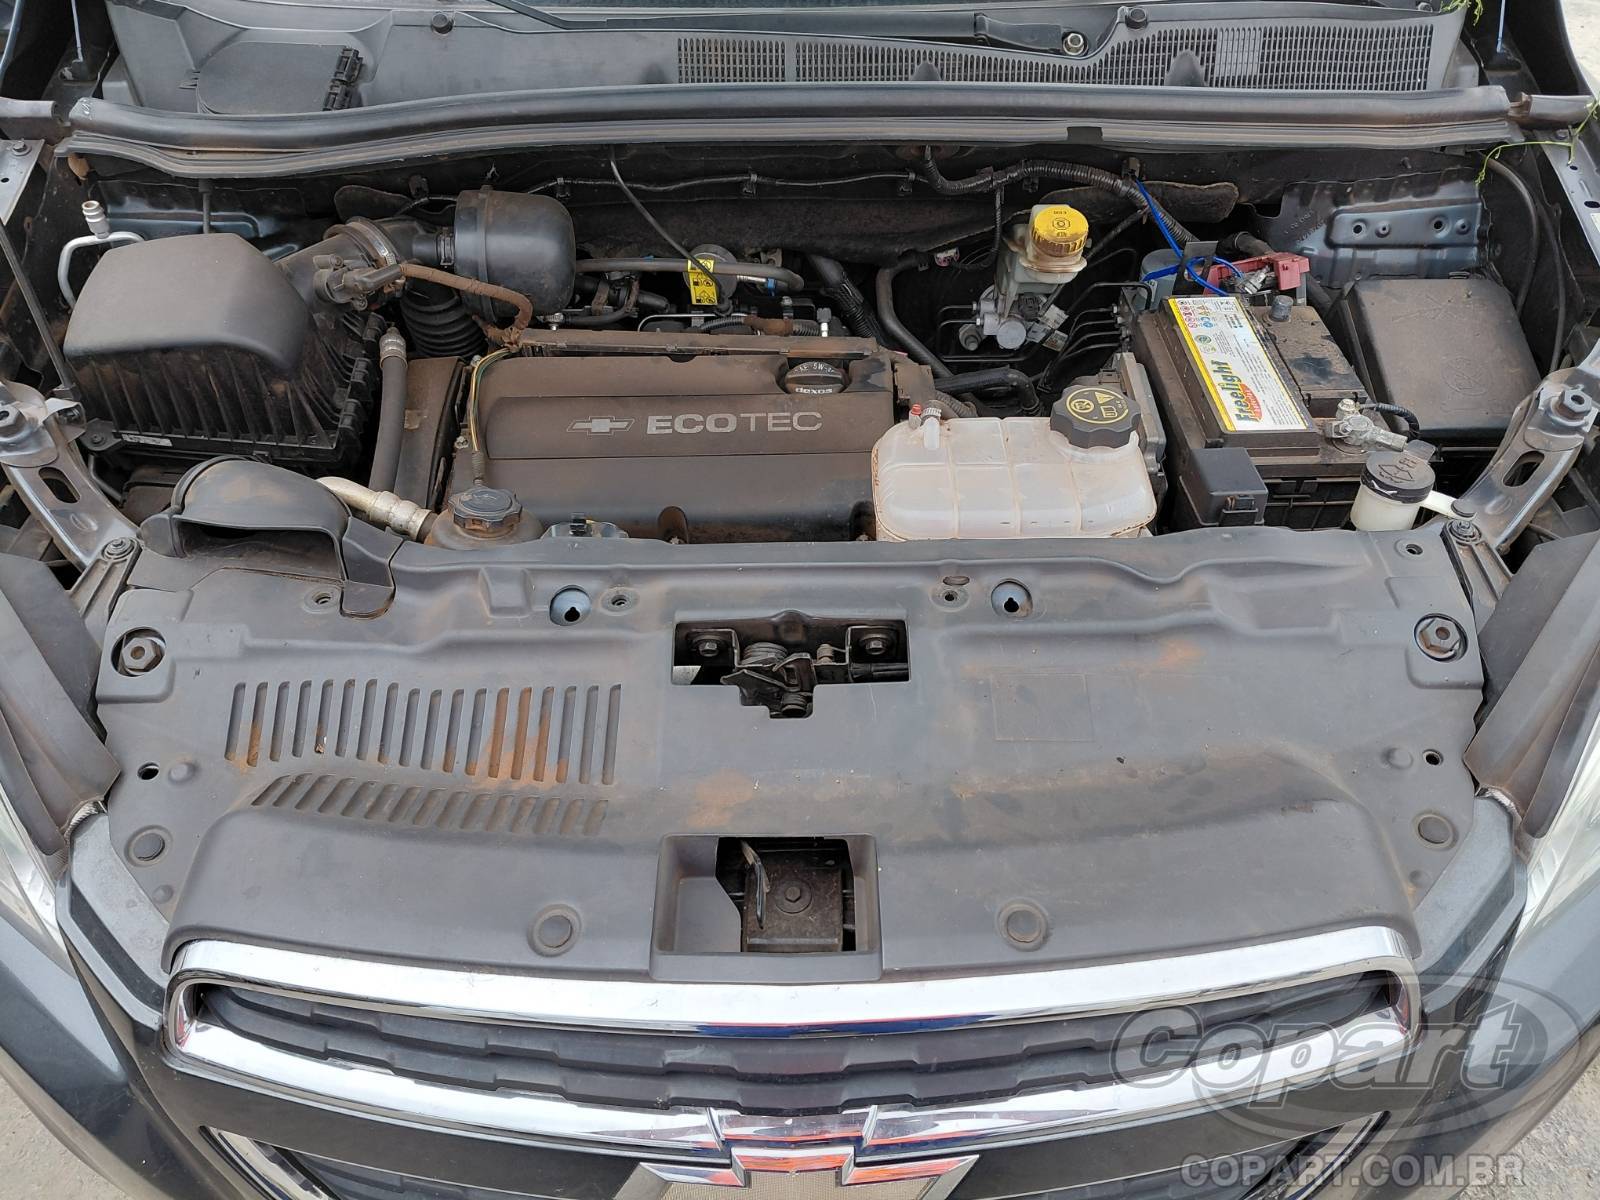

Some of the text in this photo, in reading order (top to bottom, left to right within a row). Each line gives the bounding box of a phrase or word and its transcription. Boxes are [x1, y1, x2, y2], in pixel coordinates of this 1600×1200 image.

[795, 387, 833, 395] dexos
[1210, 360, 1260, 422] Freelight
[646, 411, 823, 435] ECOTEC
